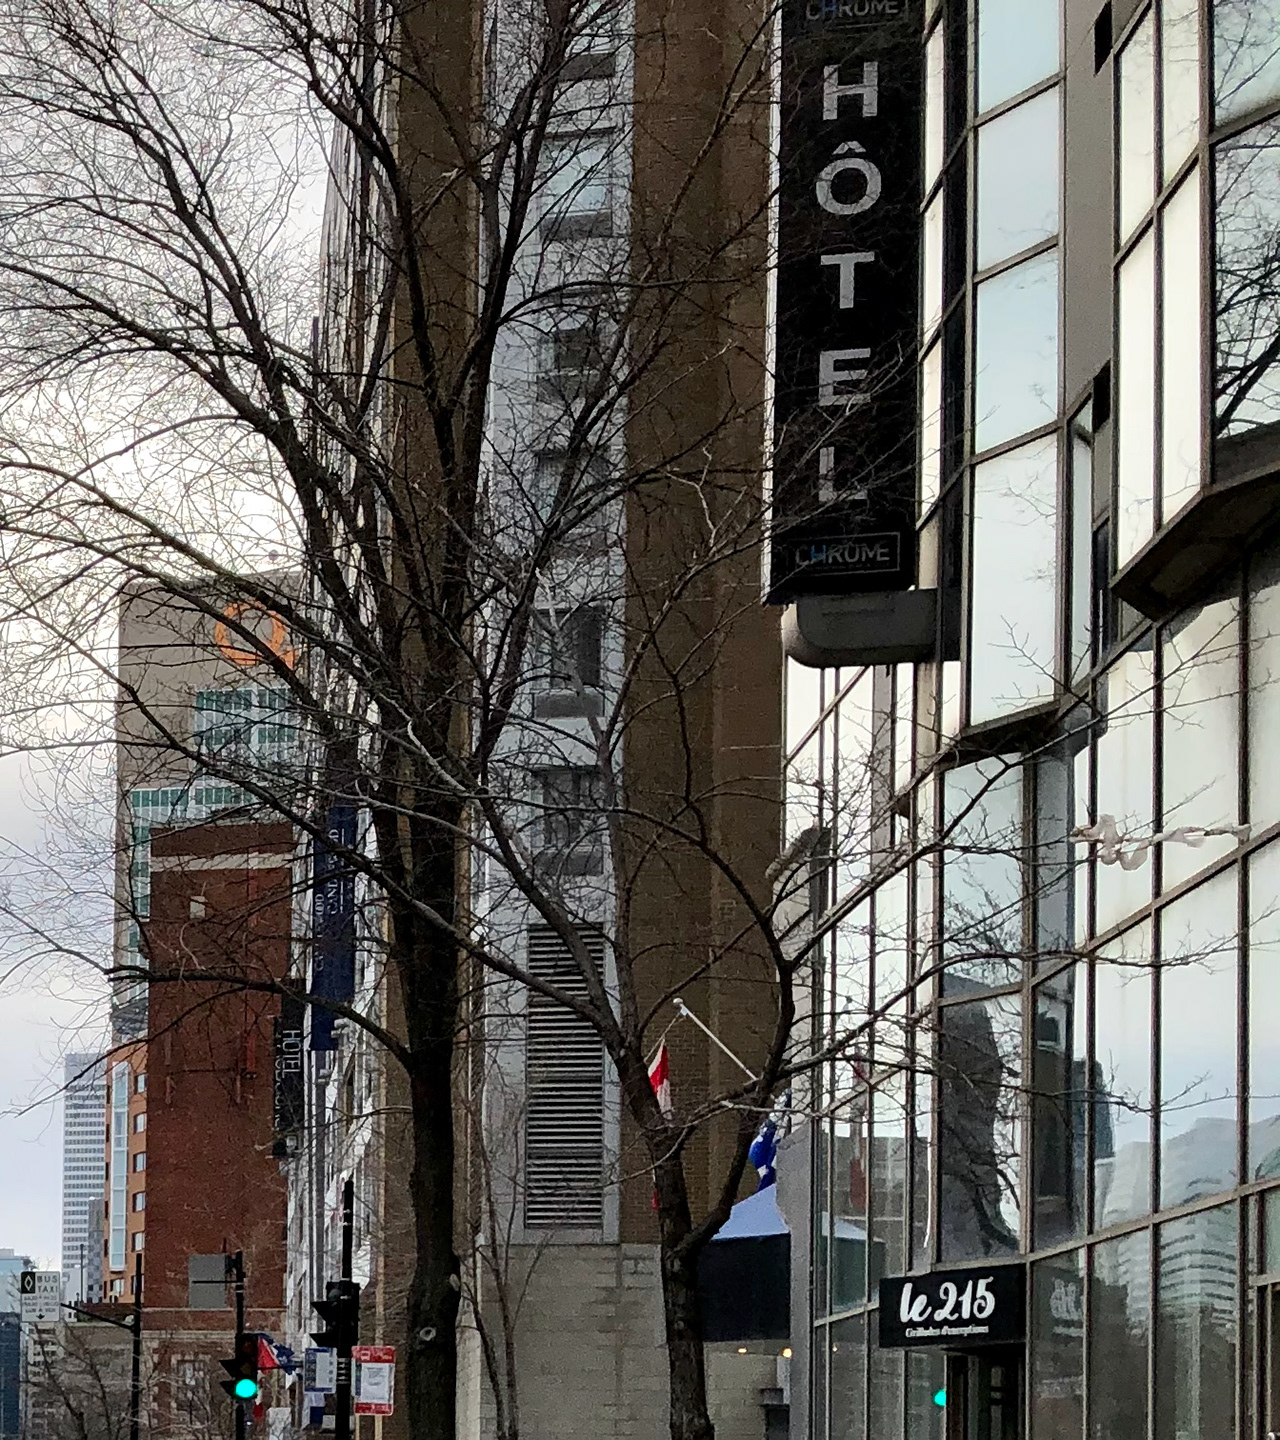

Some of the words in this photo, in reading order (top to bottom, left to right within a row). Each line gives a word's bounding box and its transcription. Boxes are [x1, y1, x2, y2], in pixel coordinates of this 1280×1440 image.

[815, 61, 882, 503] HÔTEL
[282, 1029, 301, 1079] HOTEL
[36, 1275, 58, 1283] BUS
[37, 1285, 58, 1293] TAXI
[899, 1282, 932, 1323] le
[934, 1276, 996, 1322] 215
